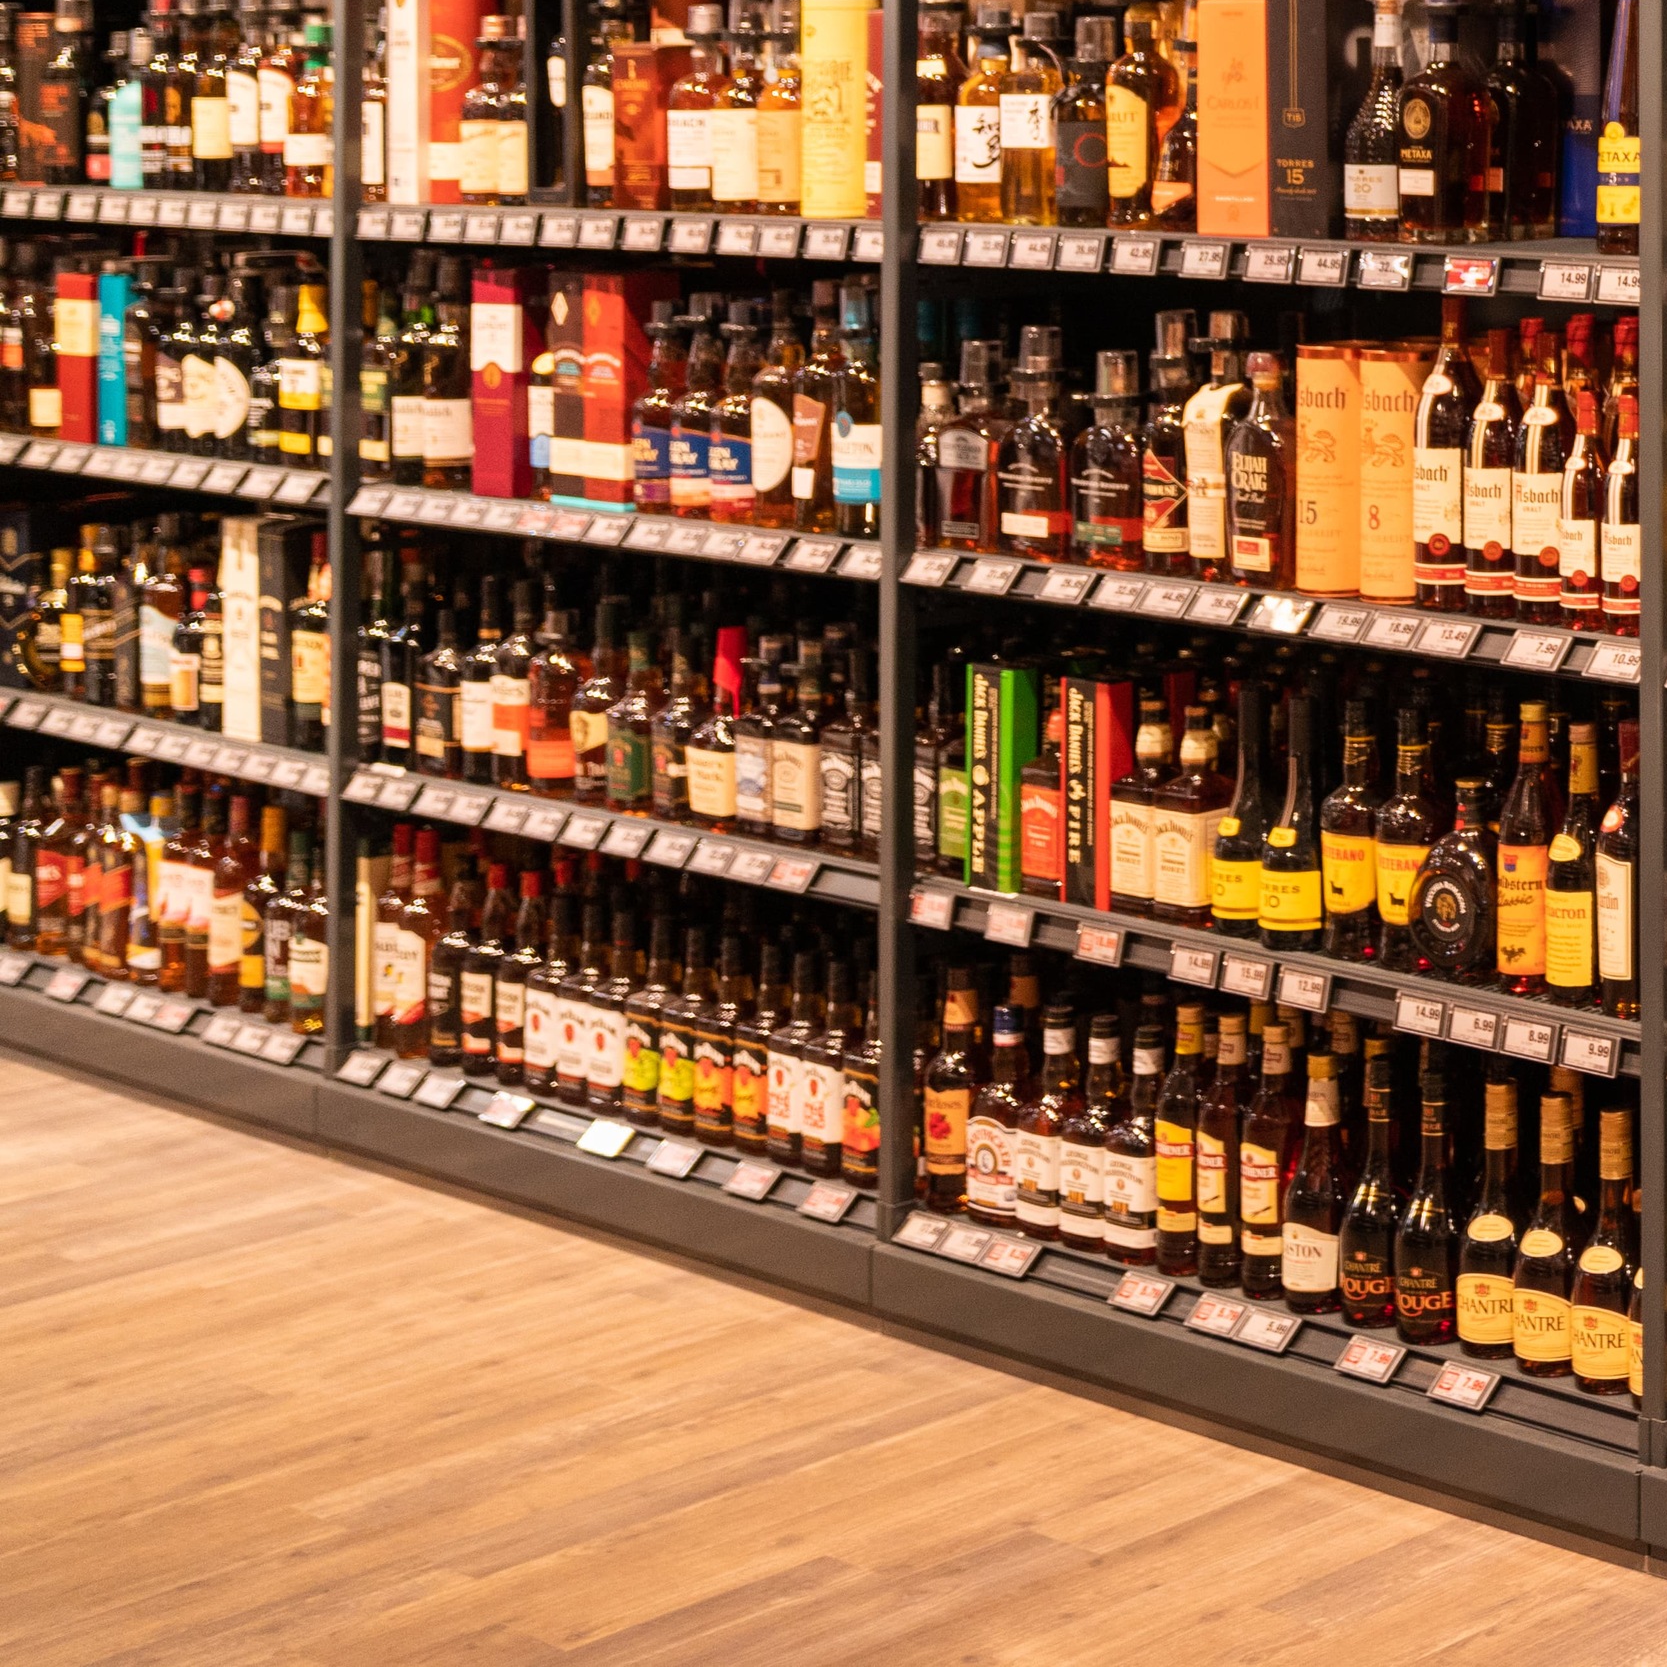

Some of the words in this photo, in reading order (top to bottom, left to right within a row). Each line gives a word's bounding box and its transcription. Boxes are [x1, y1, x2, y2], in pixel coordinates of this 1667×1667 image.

[1368, 504, 1381, 530] 8
[972, 789, 986, 873] APPLE
[1068, 805, 1081, 864] FIRE
